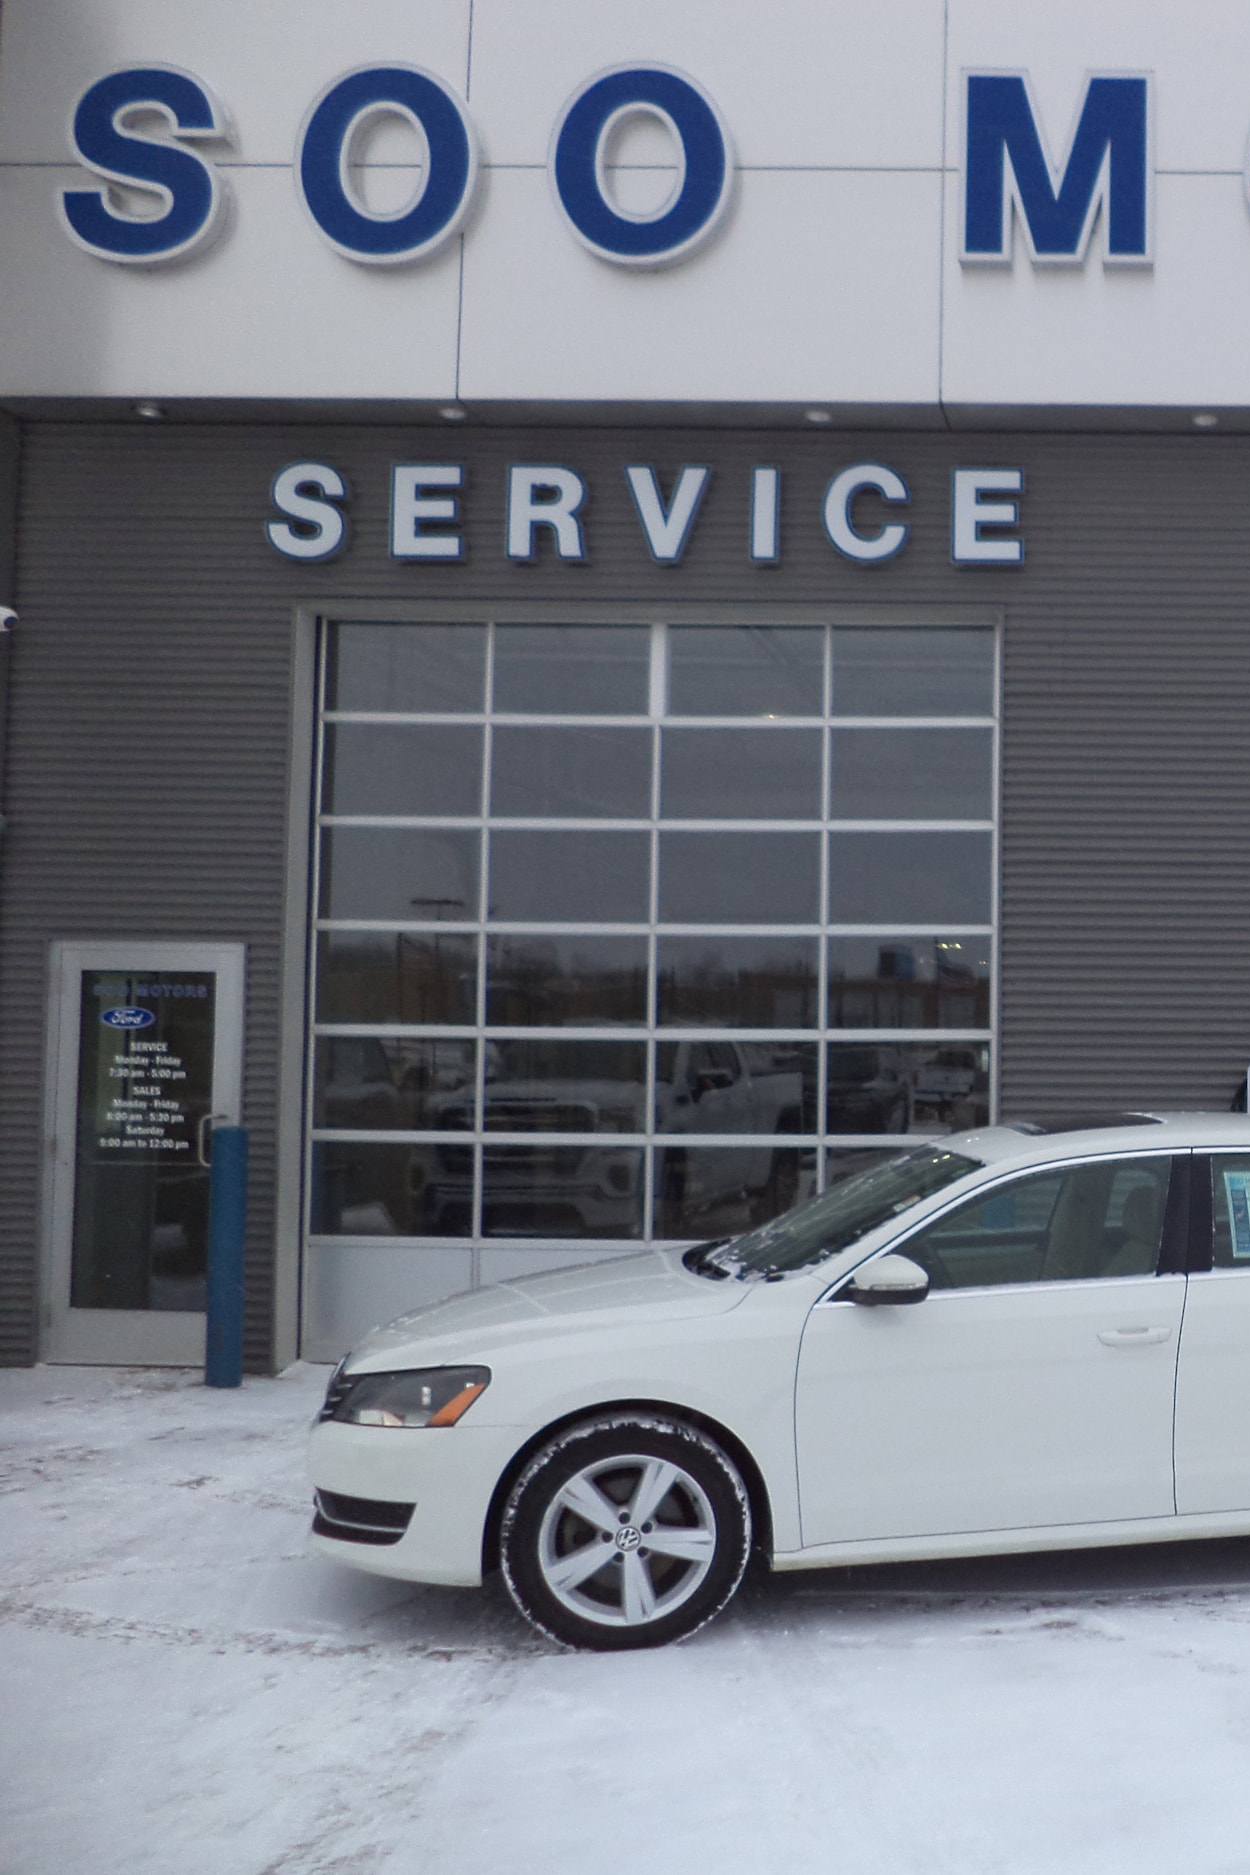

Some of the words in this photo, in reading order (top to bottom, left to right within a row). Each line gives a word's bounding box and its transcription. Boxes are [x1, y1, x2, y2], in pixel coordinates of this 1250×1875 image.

[61, 65, 728, 258] SOO
[269, 465, 1021, 560] SERVICE
[130, 1042, 168, 1052] SERVICE
[156, 1056, 182, 1067] Friday
[133, 1086, 161, 1096] SALES
[153, 1100, 180, 1111] Friday
[126, 1124, 165, 1136] Saturday
